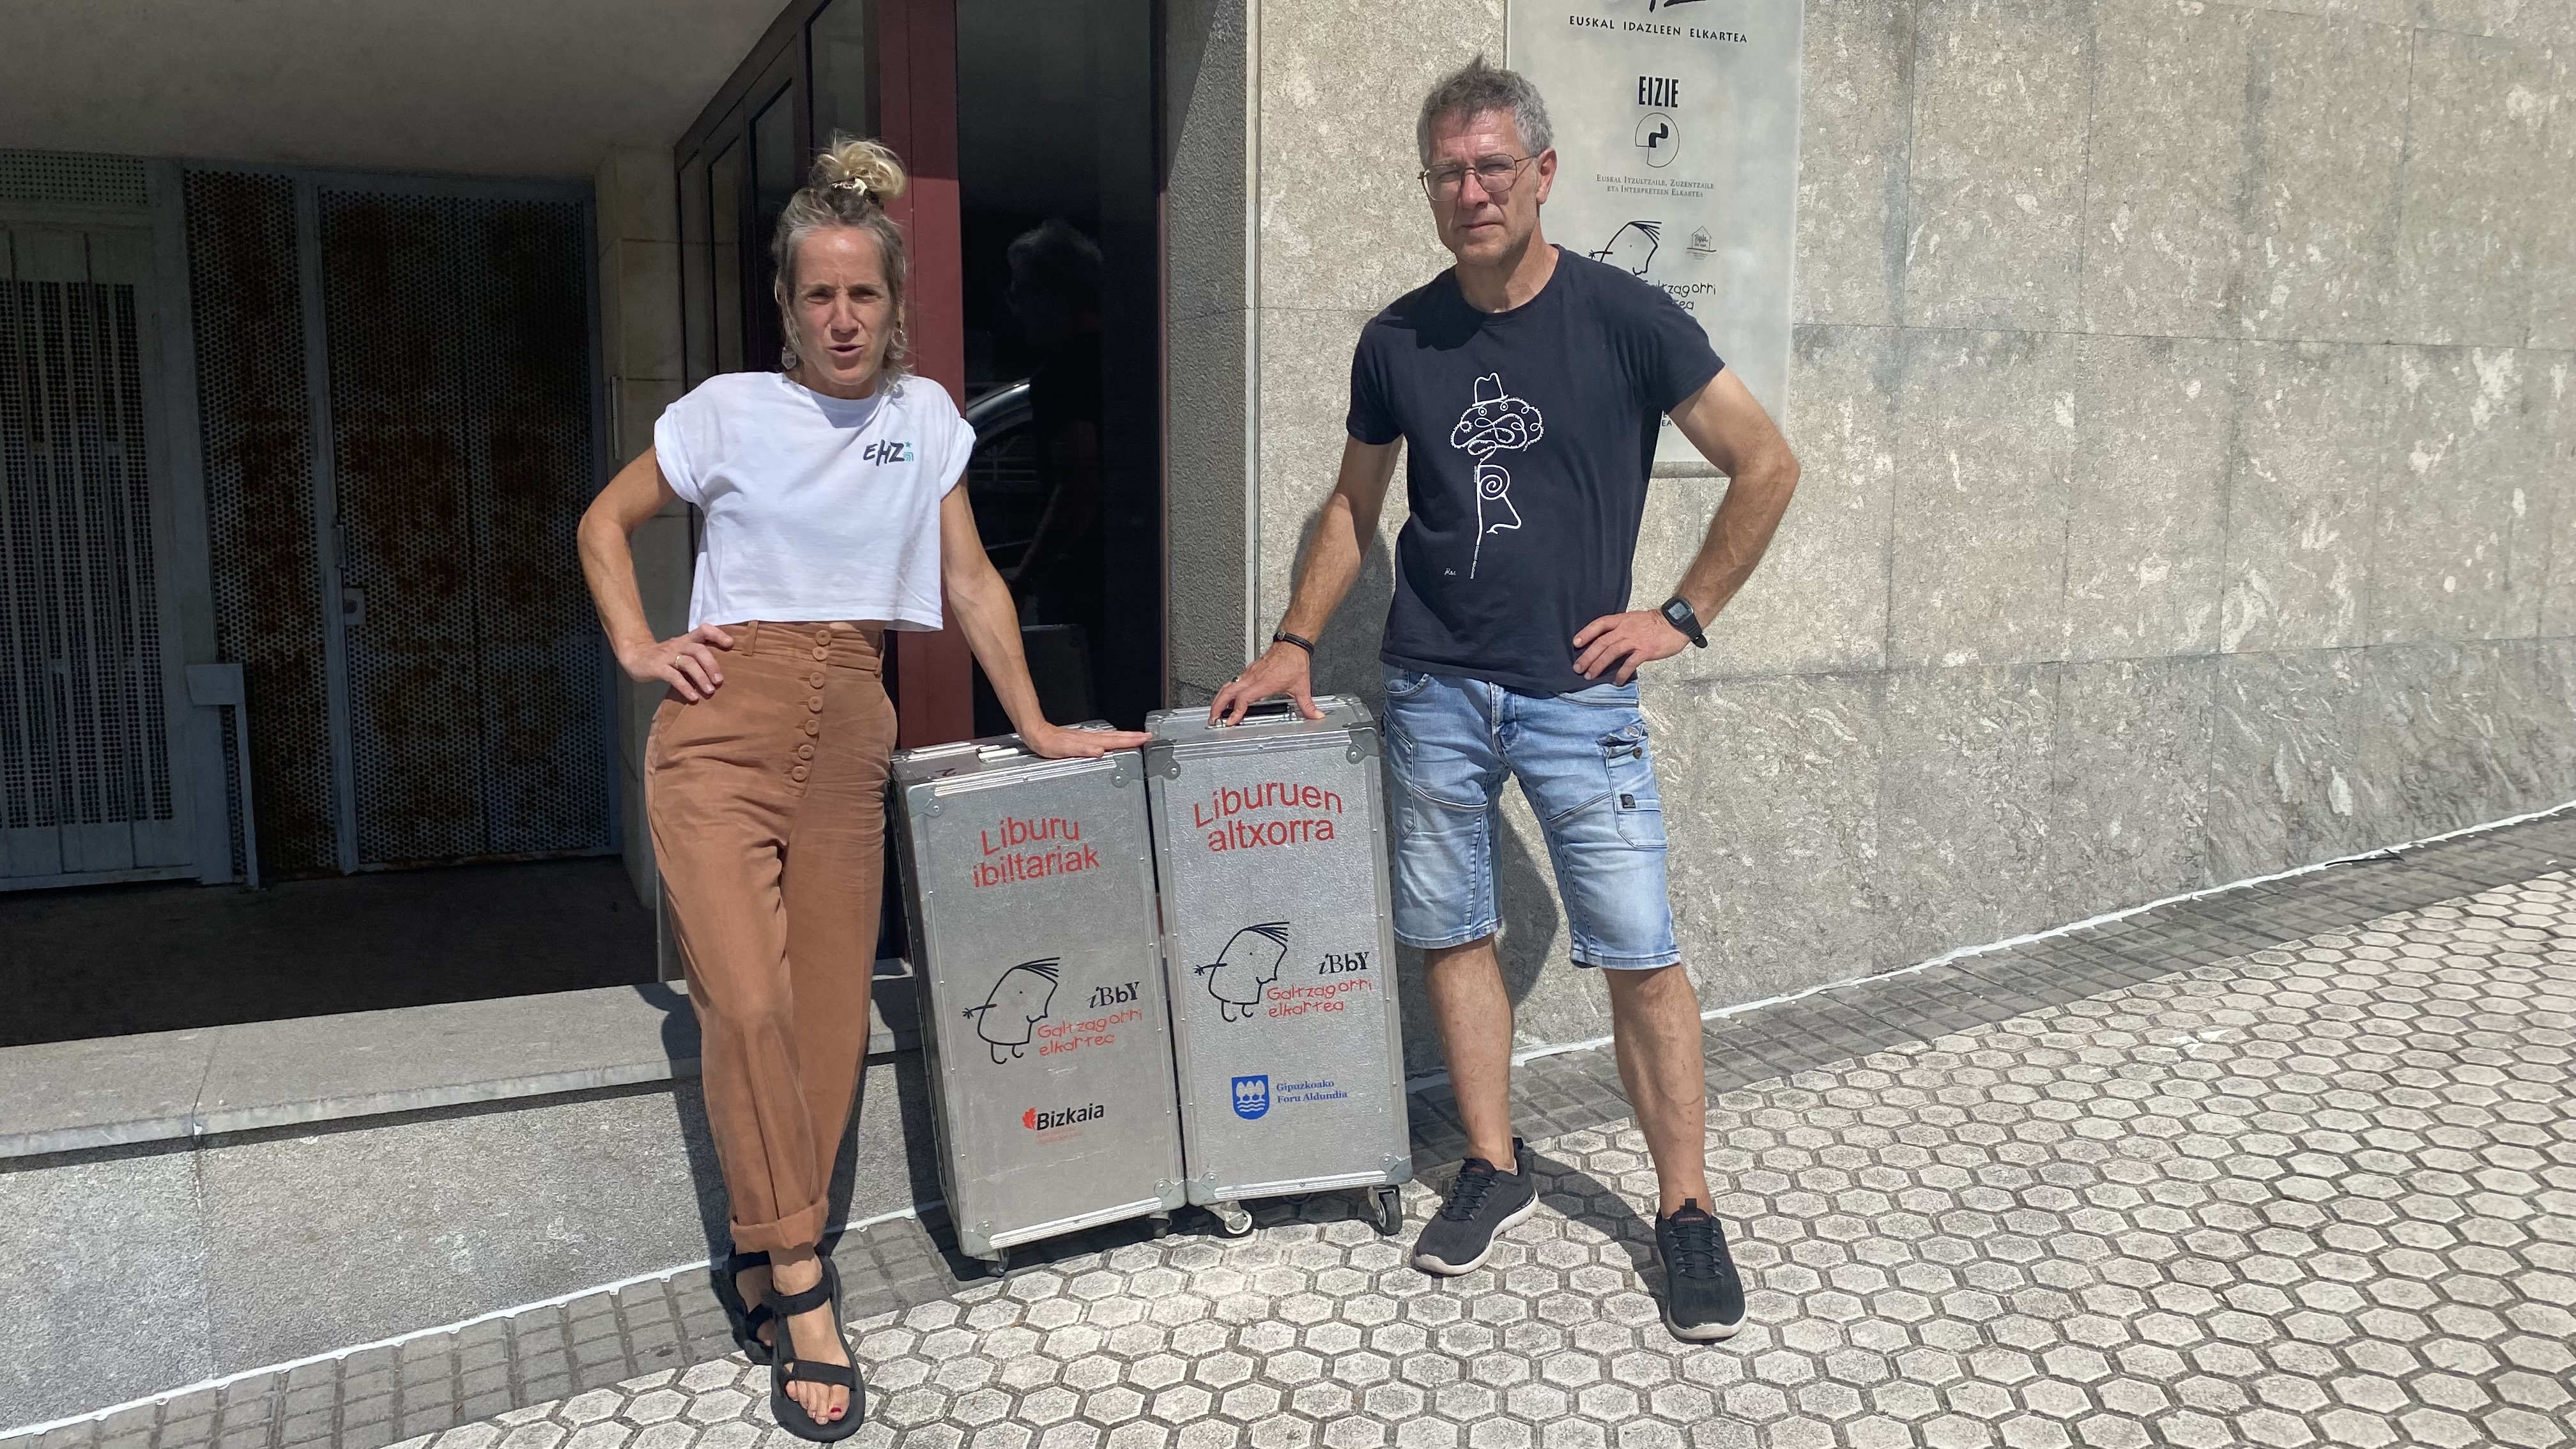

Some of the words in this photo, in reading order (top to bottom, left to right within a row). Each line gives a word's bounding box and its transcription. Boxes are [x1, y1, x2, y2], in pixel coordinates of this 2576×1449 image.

[1569, 15, 1615, 30] EUSKAL
[1623, 21, 1682, 36] IDAZLEEN
[1689, 28, 1748, 43] ELKARTEA
[1638, 75, 1680, 108] EIZIE
[862, 439, 905, 466] EHZ
[1193, 782, 1342, 829] Liburuen
[981, 816, 1080, 856] Liburu
[1208, 819, 1335, 852] altxorra
[972, 843, 1100, 888] ibiltariak
[1267, 978, 1372, 1000] Galtzagorri
[1268, 1000, 1344, 1017] elkartea
[1037, 1008, 1143, 1038] Galtzagorri
[1038, 1033, 1116, 1056] elkartea
[1276, 1079, 1335, 1092] Gipuzkoako
[1277, 1095, 1301, 1103] Foru
[1303, 1090, 1347, 1101] Aldundia
[1036, 1103, 1104, 1131] Bizkaia
